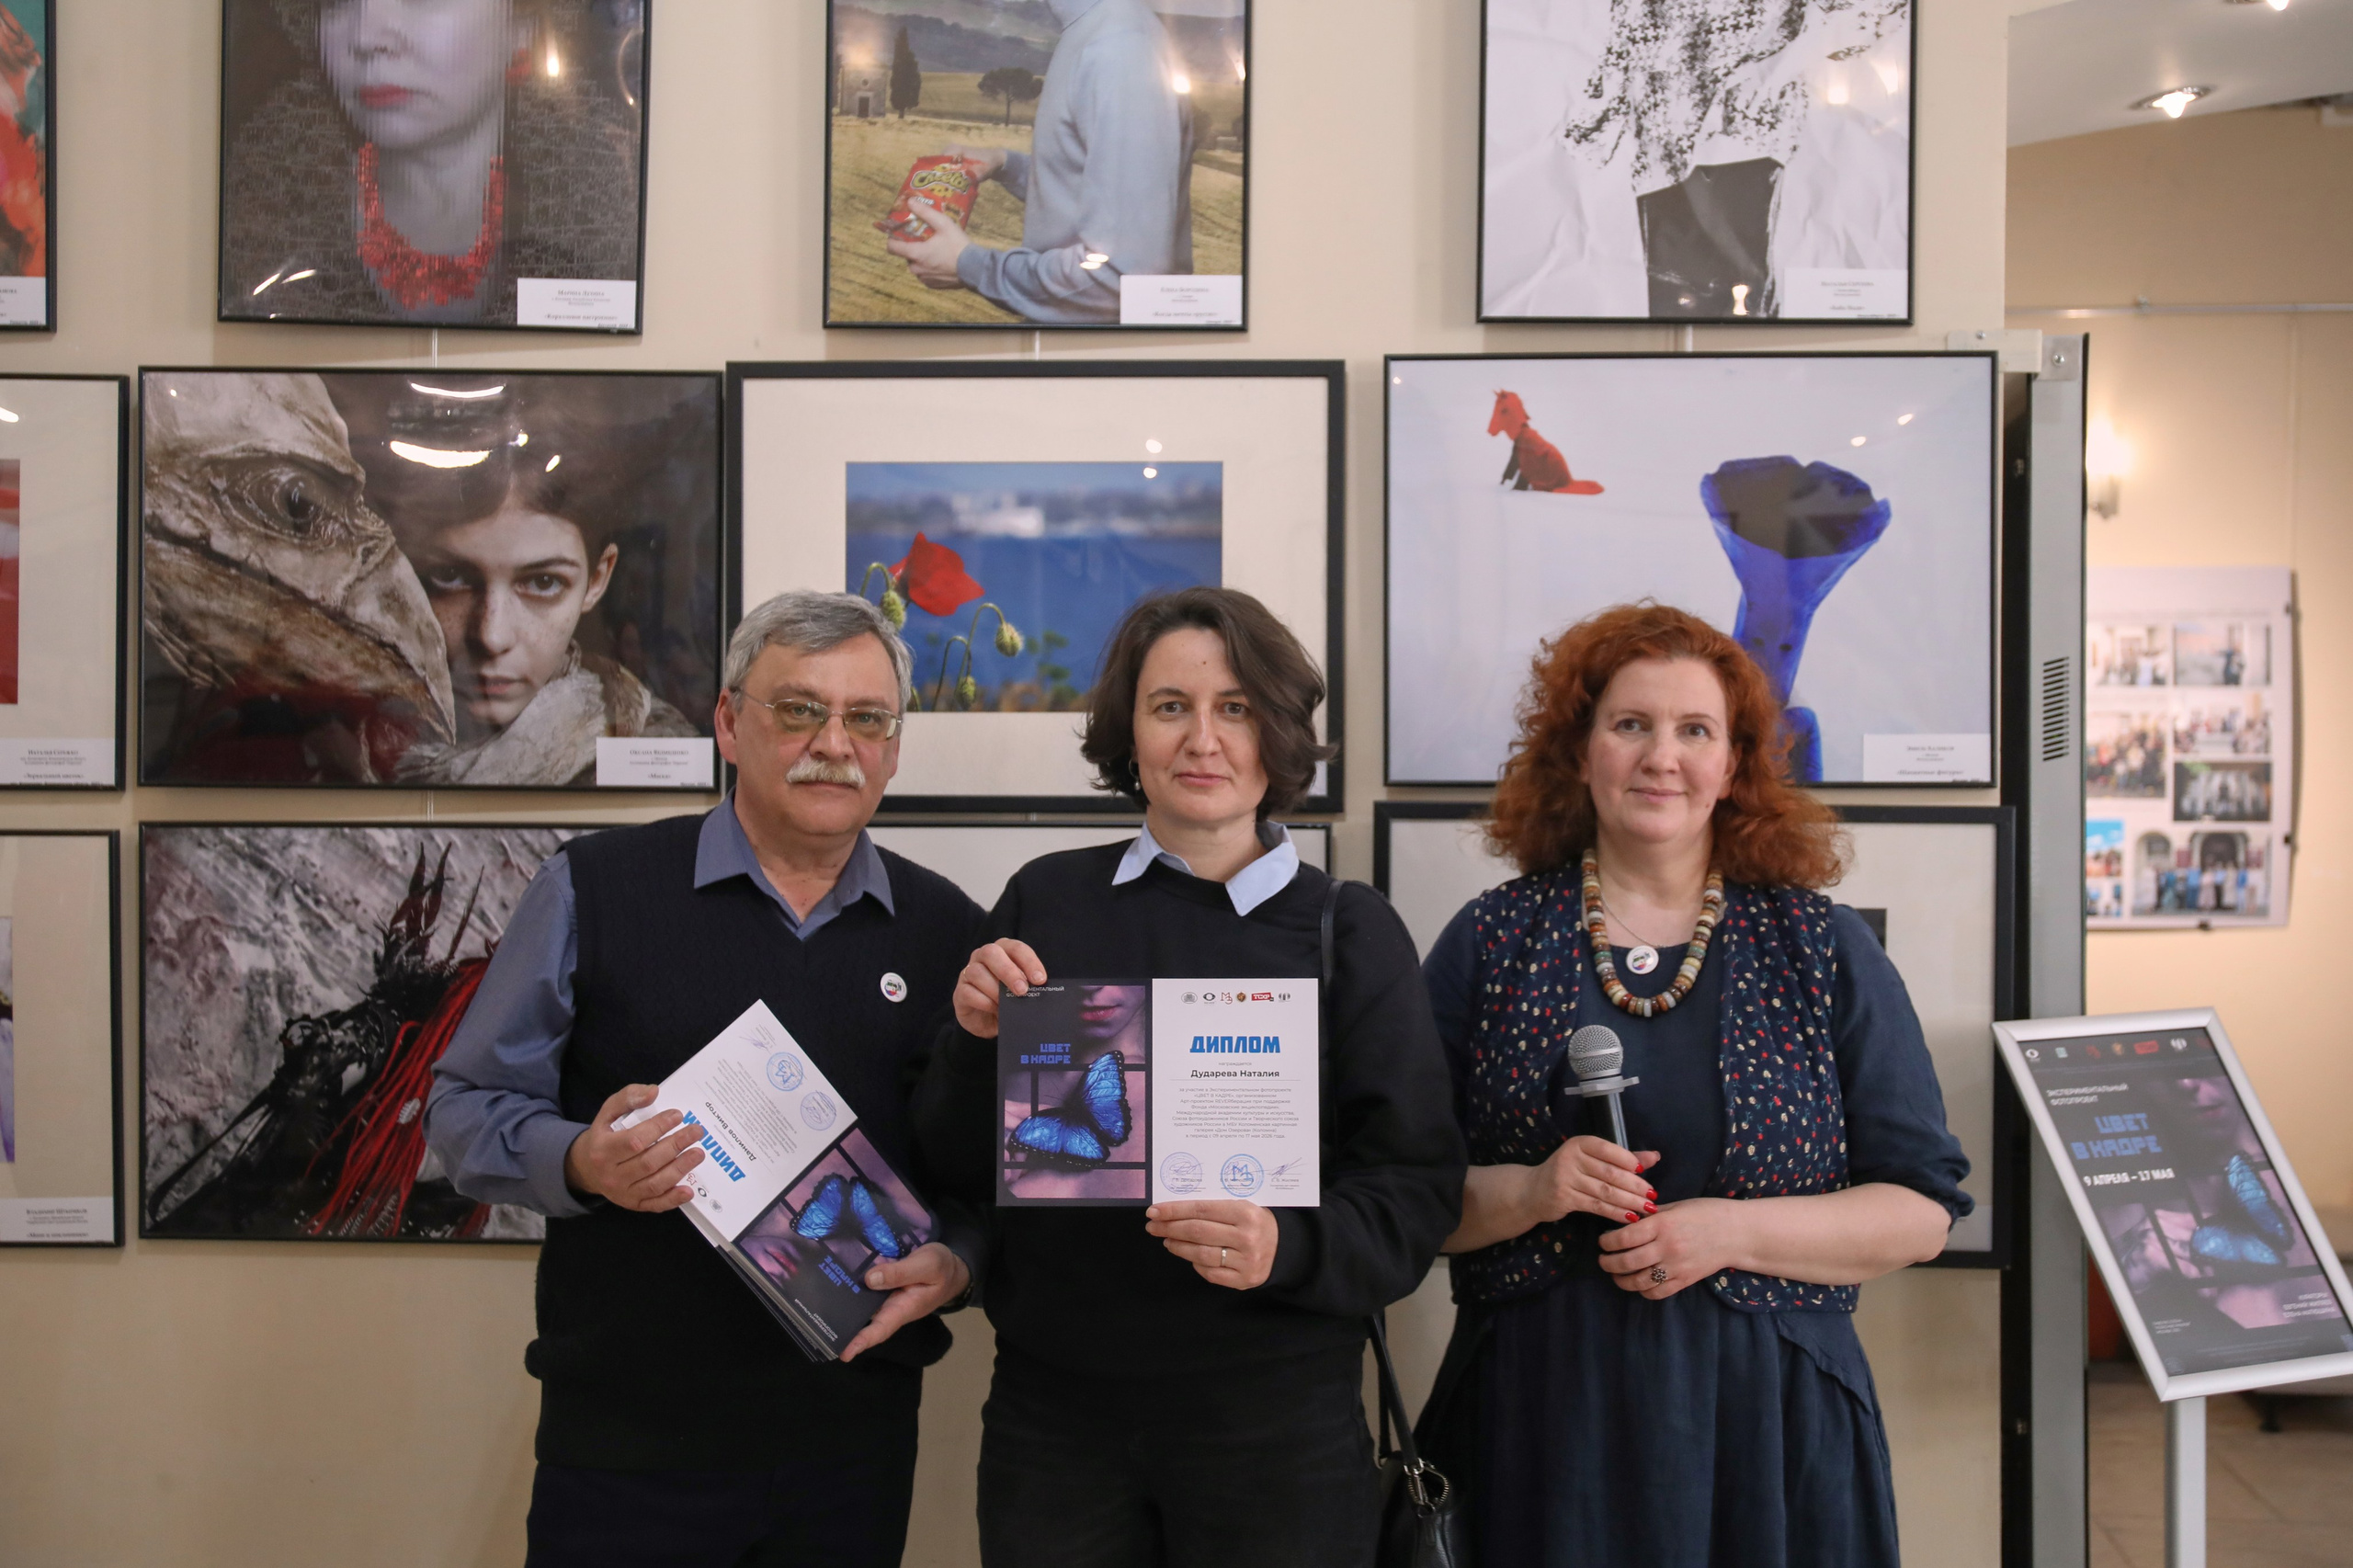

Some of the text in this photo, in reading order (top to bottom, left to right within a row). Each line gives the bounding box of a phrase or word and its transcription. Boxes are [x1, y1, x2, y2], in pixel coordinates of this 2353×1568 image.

[1040, 1043, 1071, 1052] ЦВЕТ
[1189, 1036, 1280, 1053] ДИПЛОМ
[1020, 1055, 1071, 1063] В КАДРЕ
[1190, 1070, 1237, 1078] Дударева
[705, 1101, 729, 1130] Виктор
[2095, 1113, 2149, 1134] ЦВЕТ
[728, 1129, 756, 1161] Данилов
[2070, 1135, 2163, 1160] В КАДРЕ
[2083, 1176, 2092, 1187] 9
[2093, 1172, 2131, 1186] АПРЕЛЯ
[2138, 1170, 2151, 1181] 17
[2151, 1168, 2175, 1180] МАЯ
